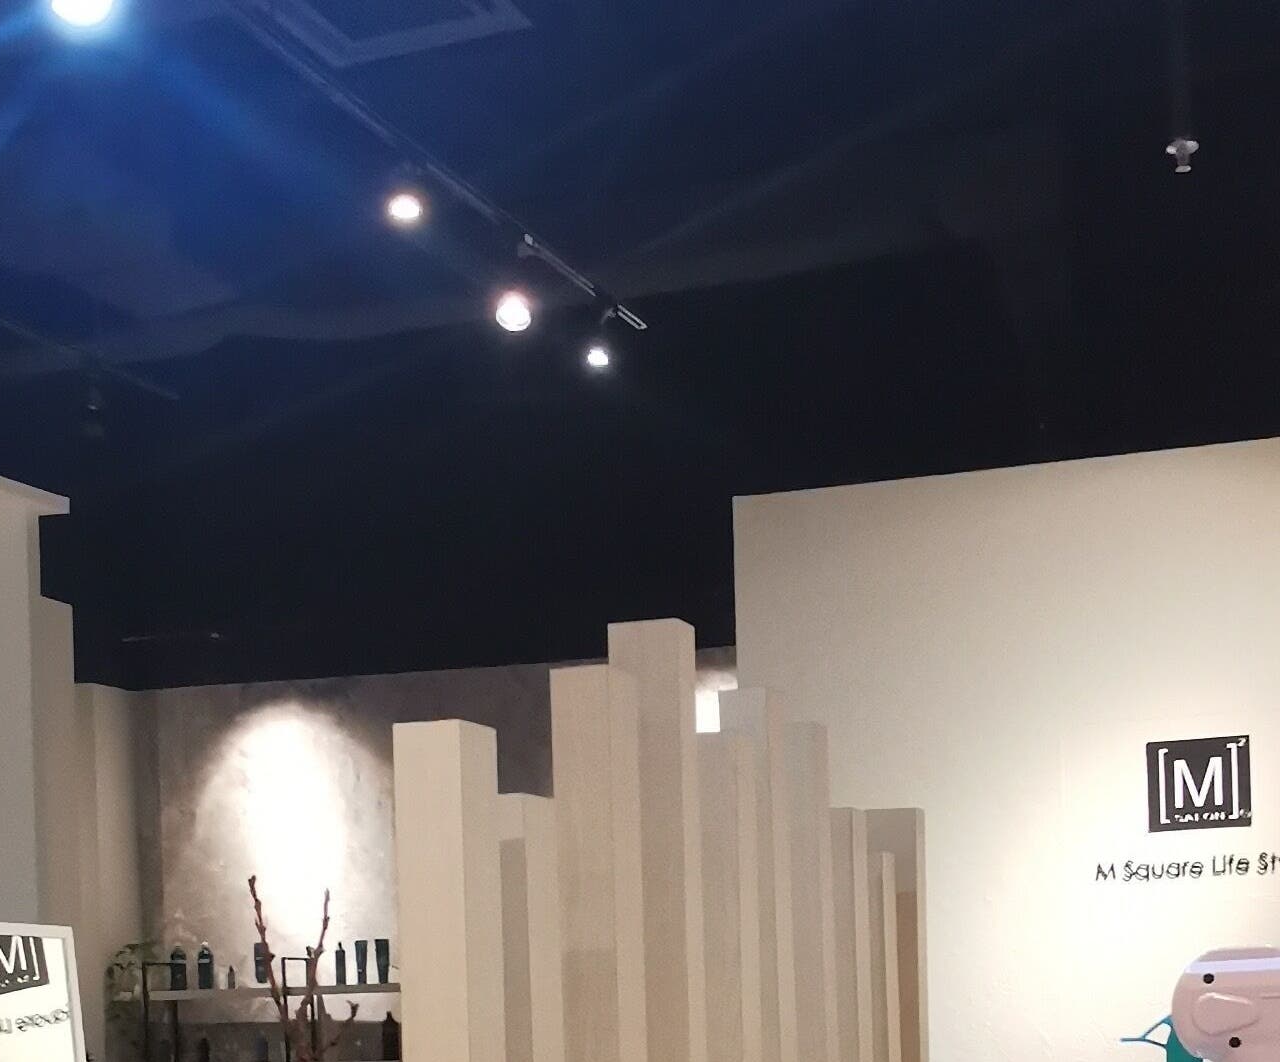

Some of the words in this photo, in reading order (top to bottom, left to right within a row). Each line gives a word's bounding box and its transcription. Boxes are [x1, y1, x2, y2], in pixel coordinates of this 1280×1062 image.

[1095, 862, 1117, 881] M
[1122, 860, 1204, 883] Square
[1212, 854, 1250, 876] Life
